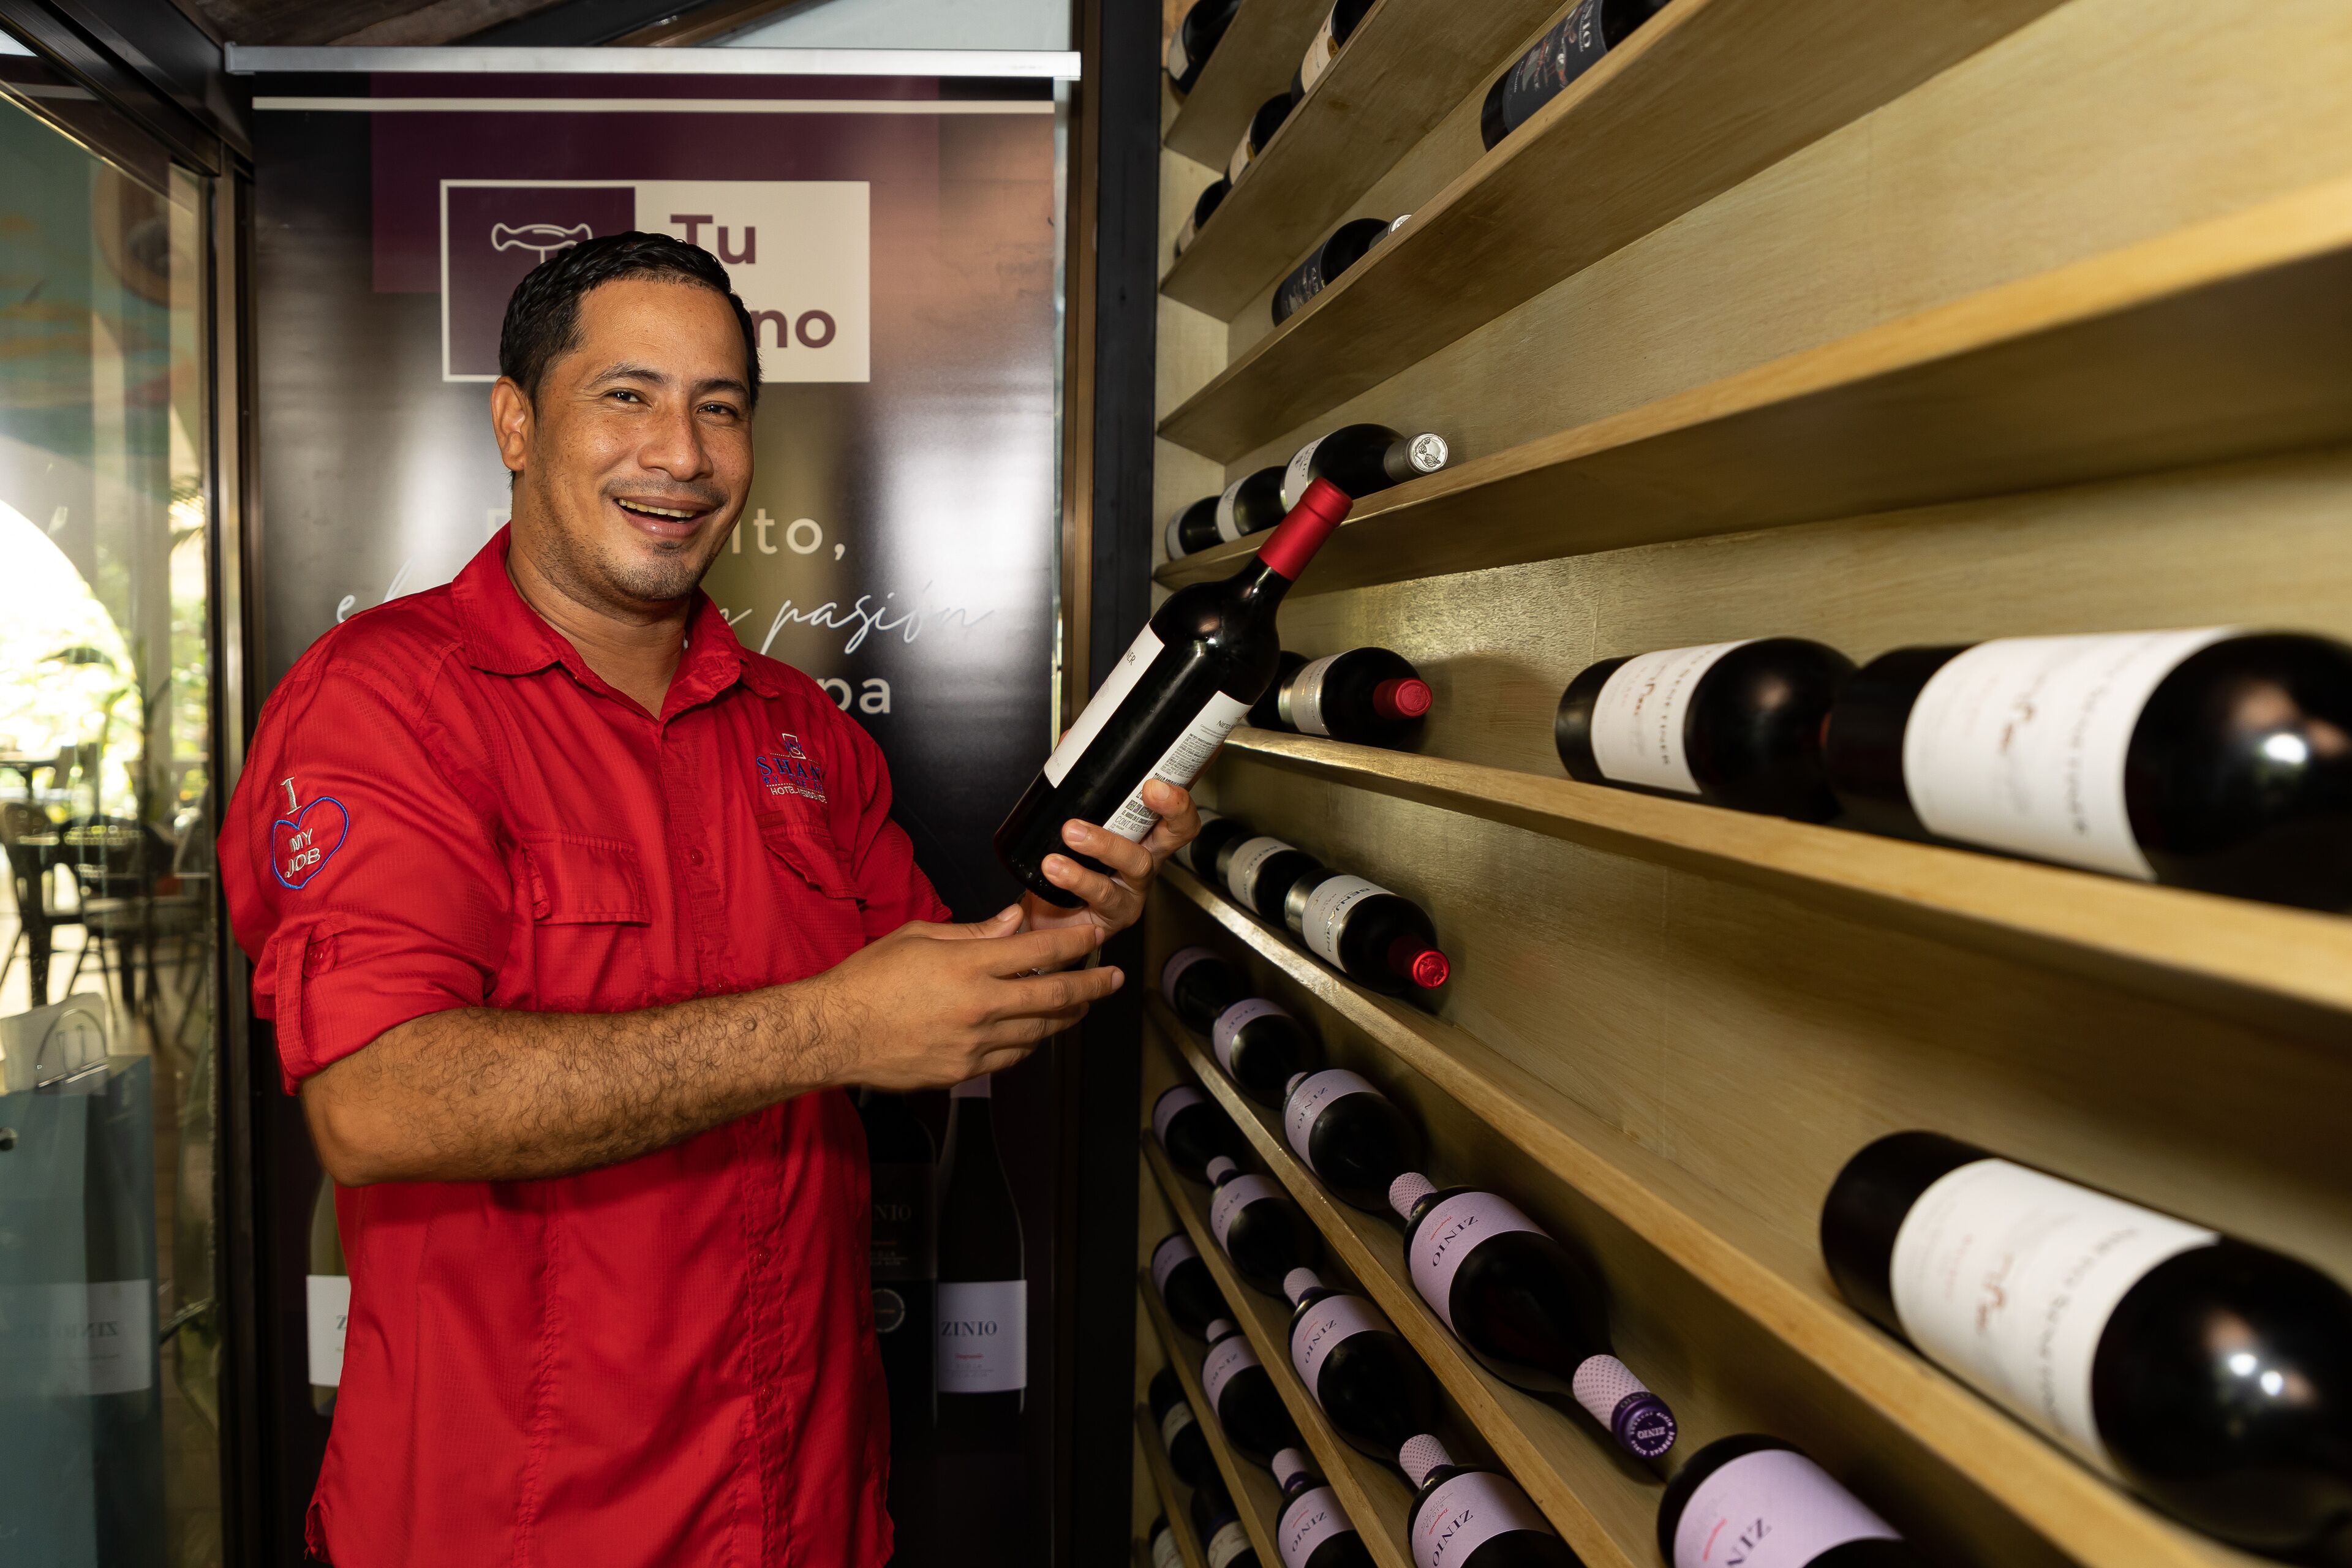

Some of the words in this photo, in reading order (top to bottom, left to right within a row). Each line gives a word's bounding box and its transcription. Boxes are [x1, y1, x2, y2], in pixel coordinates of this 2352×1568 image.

[670, 214, 756, 264] Tu
[750, 309, 835, 349] no
[816, 677, 891, 714] pa
[756, 756, 823, 784] SHAN
[280, 776, 302, 815] I
[771, 786, 798, 796] HOTEL
[289, 828, 312, 853] MY
[284, 848, 320, 878] JOB
[872, 1204, 912, 1222] NIO
[1433, 1216, 1479, 1267] ZINIO
[941, 1320, 998, 1338] ZINIO
[1305, 1319, 1337, 1363] ZINIO
[1637, 1426, 1667, 1440] ZINIO
[1292, 1511, 1327, 1552] ZINIO
[1433, 1509, 1474, 1567] ZINIO
[1720, 1517, 1773, 1568] ZIN
